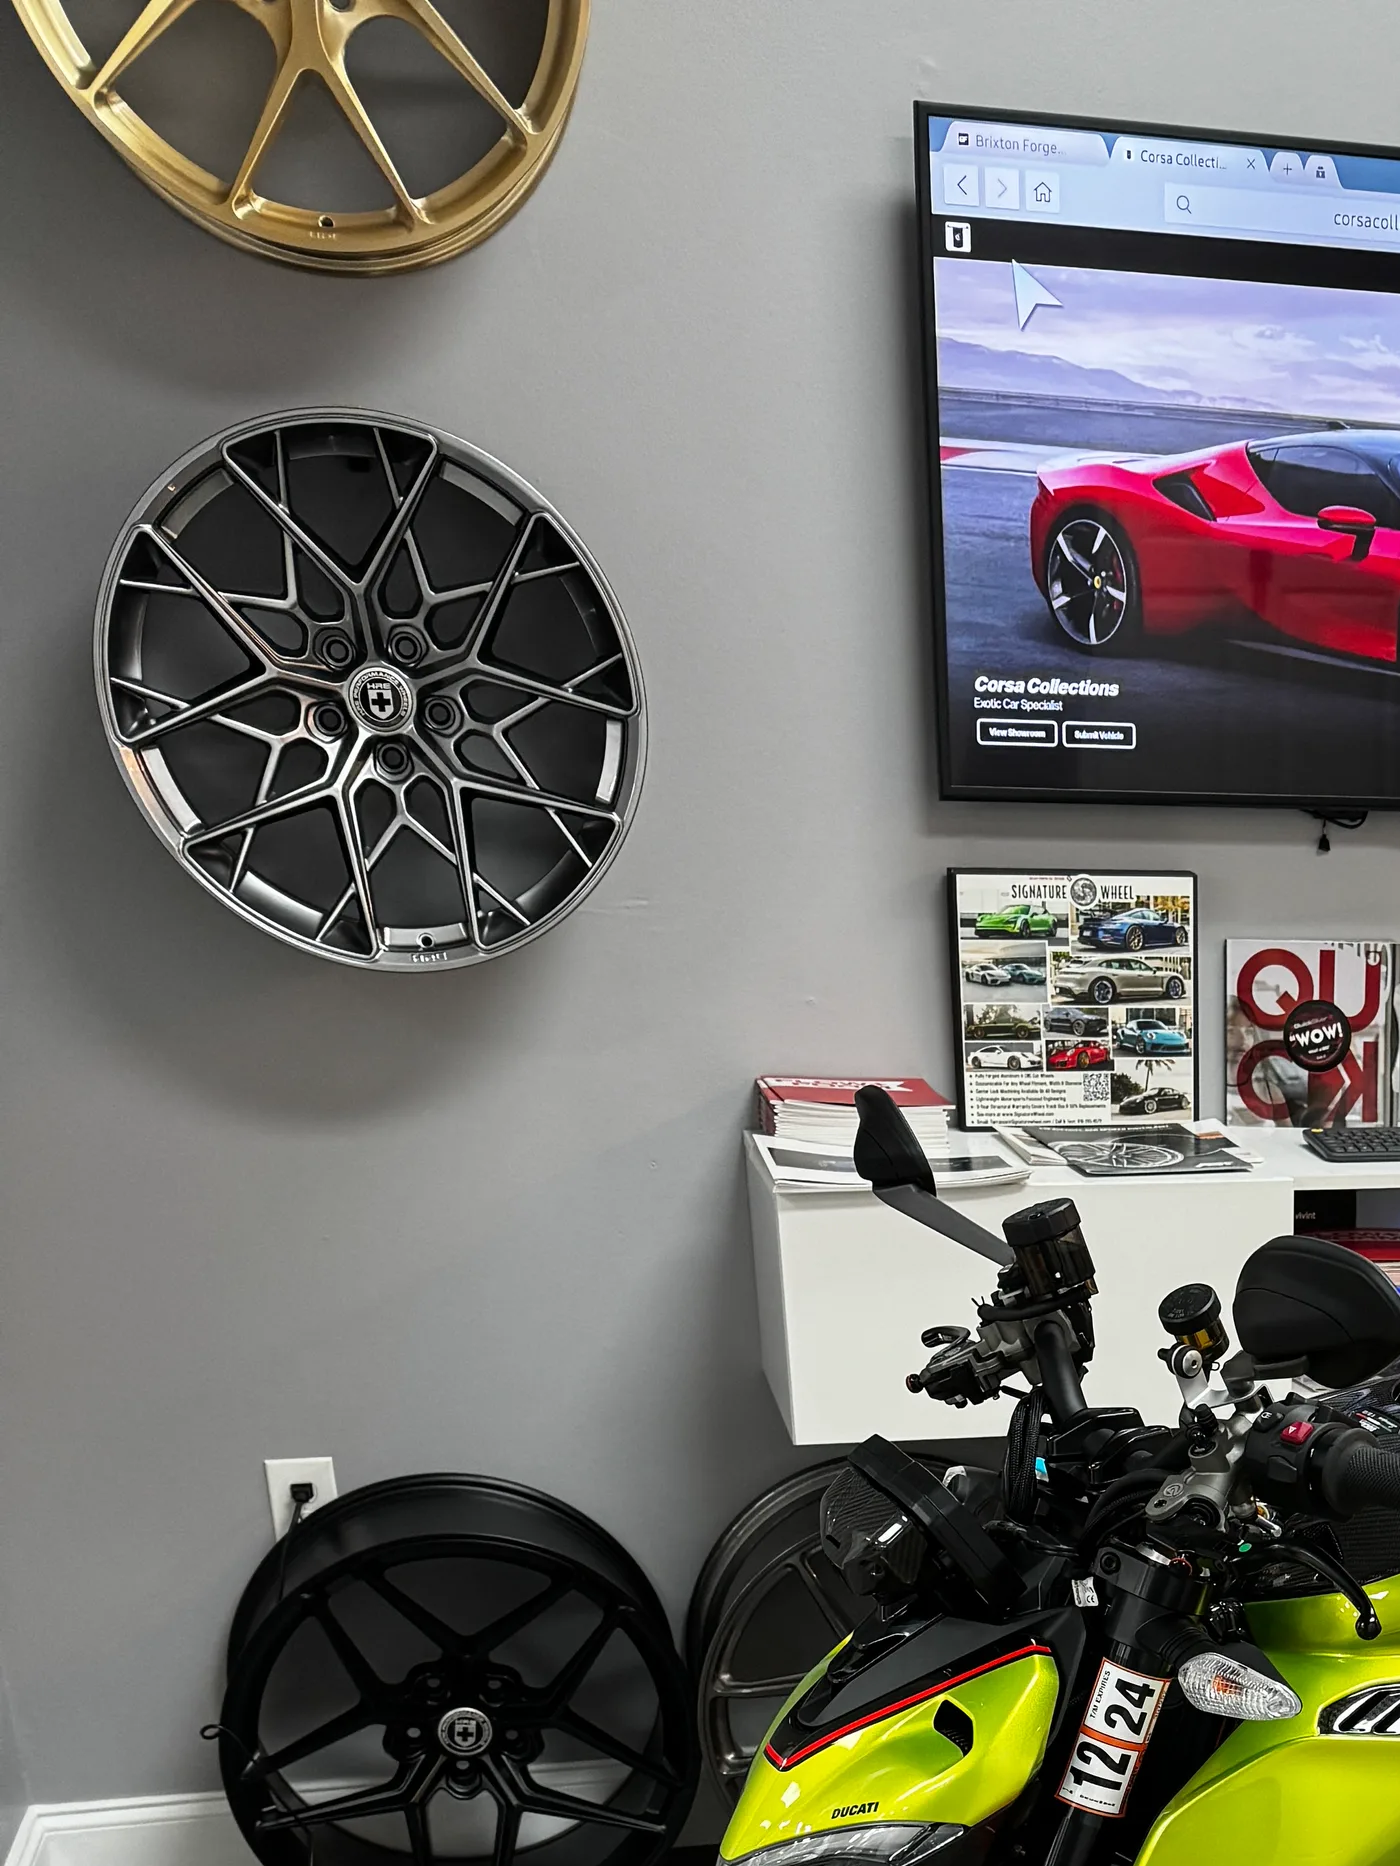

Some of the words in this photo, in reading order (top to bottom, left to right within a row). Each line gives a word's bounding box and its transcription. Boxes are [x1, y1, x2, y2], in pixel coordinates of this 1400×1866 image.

[976, 135, 1019, 151] Brixton
[1141, 150, 1173, 165] Corsa
[974, 676, 1026, 694] Corsa
[1027, 677, 1120, 697] Collections
[973, 697, 1002, 709] Exotic
[1002, 698, 1019, 710] Car
[1020, 699, 1063, 713] Specialist
[989, 727, 1008, 737] View
[1008, 728, 1046, 738] Showroom
[1011, 884, 1067, 899] SIGNATURE
[1100, 885, 1134, 900] WHEEL
[1069, 1740, 1132, 1791] 12
[1104, 1678, 1157, 1736] 24
[831, 1801, 880, 1820] DUCATI
